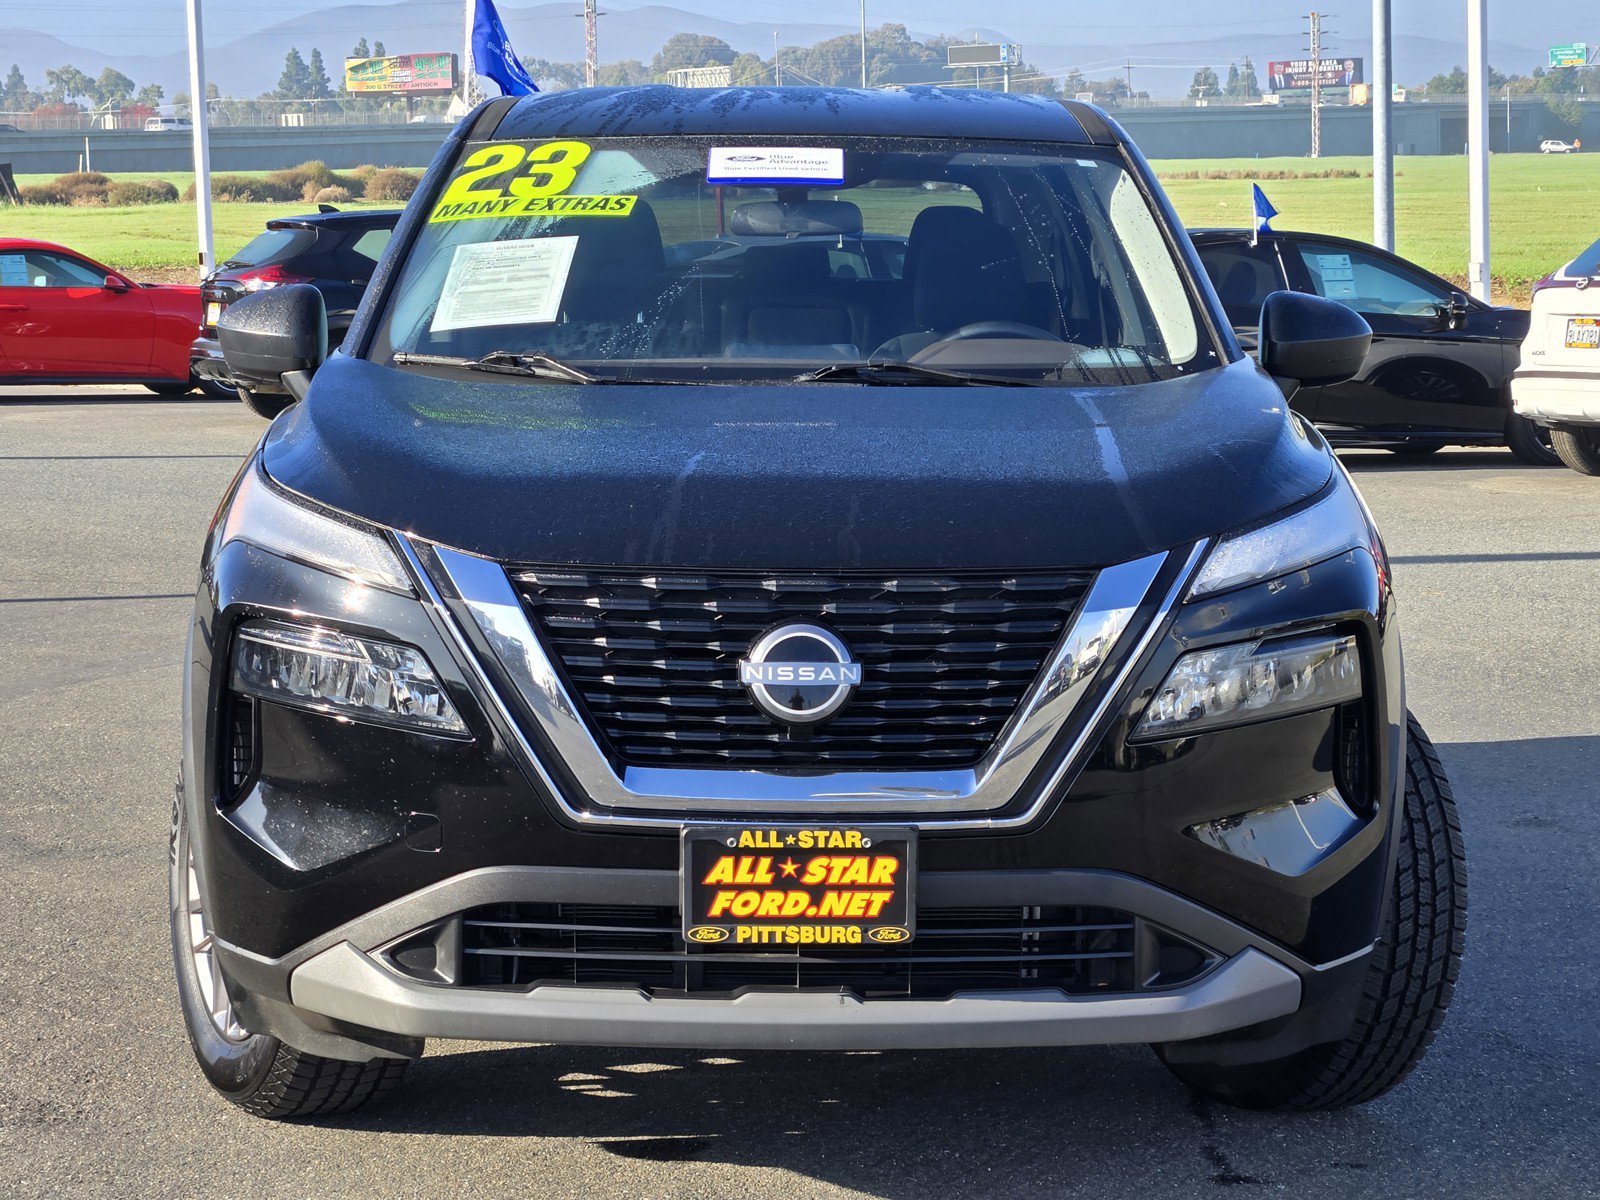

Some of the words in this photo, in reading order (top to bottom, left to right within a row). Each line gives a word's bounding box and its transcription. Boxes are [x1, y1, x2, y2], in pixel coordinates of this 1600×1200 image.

[443, 141, 592, 198] 23
[434, 199, 520, 219] MANY
[522, 196, 632, 212] EXTRAS
[746, 666, 857, 681] NISSAN
[738, 830, 784, 848] ALL
[798, 830, 862, 849] STAR
[702, 855, 775, 885] ALL
[800, 855, 899, 886] STAR
[707, 890, 894, 917] FORD.NET
[736, 926, 862, 944] PITTSBURG
